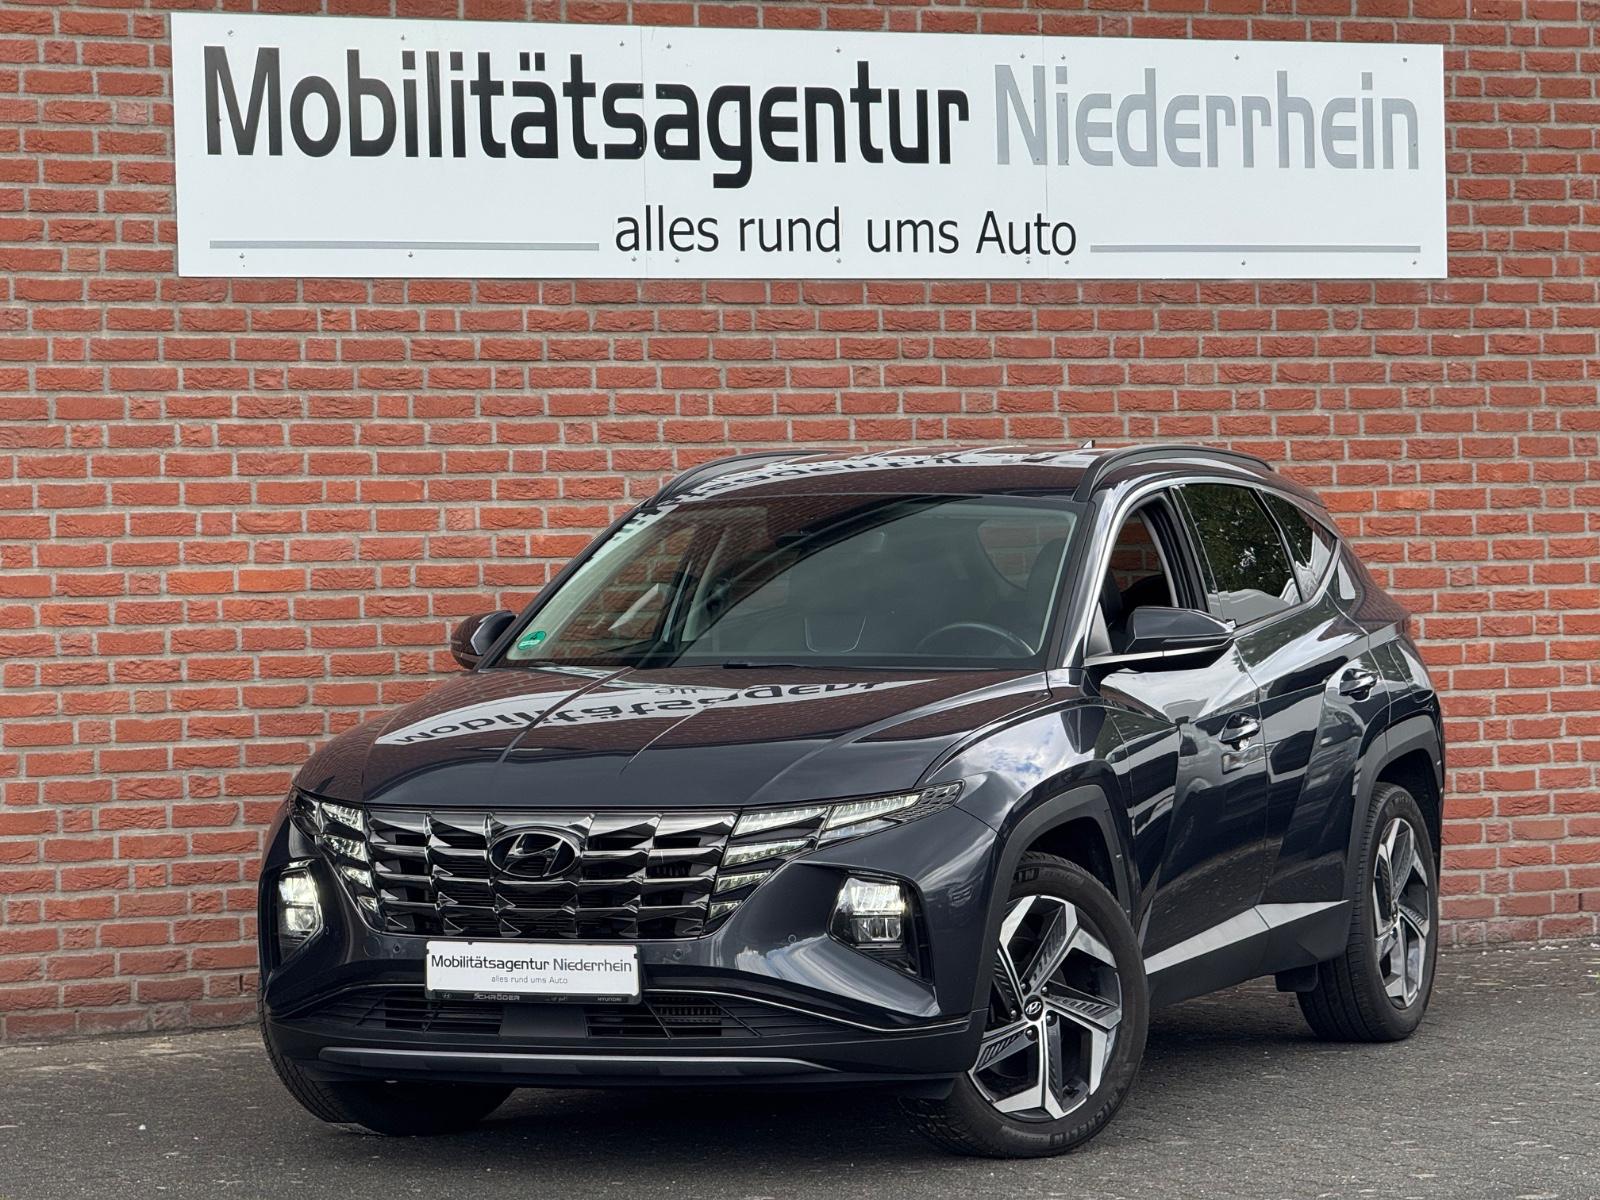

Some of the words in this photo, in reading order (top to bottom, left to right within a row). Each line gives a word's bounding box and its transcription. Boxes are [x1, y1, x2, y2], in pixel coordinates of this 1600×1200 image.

[204, 46, 969, 189] Mobilitätsagentur
[995, 64, 1419, 170] Niederrhein
[616, 205, 719, 253] alles
[739, 206, 840, 253] rund
[867, 218, 959, 255] ums
[976, 210, 1077, 256] Auto
[431, 954, 549, 973] Mobilitätsagentur
[553, 958, 632, 972] Niederrhein
[491, 975, 509, 983] alles
[510, 976, 528, 984] rund
[548, 976, 568, 984] Auto
